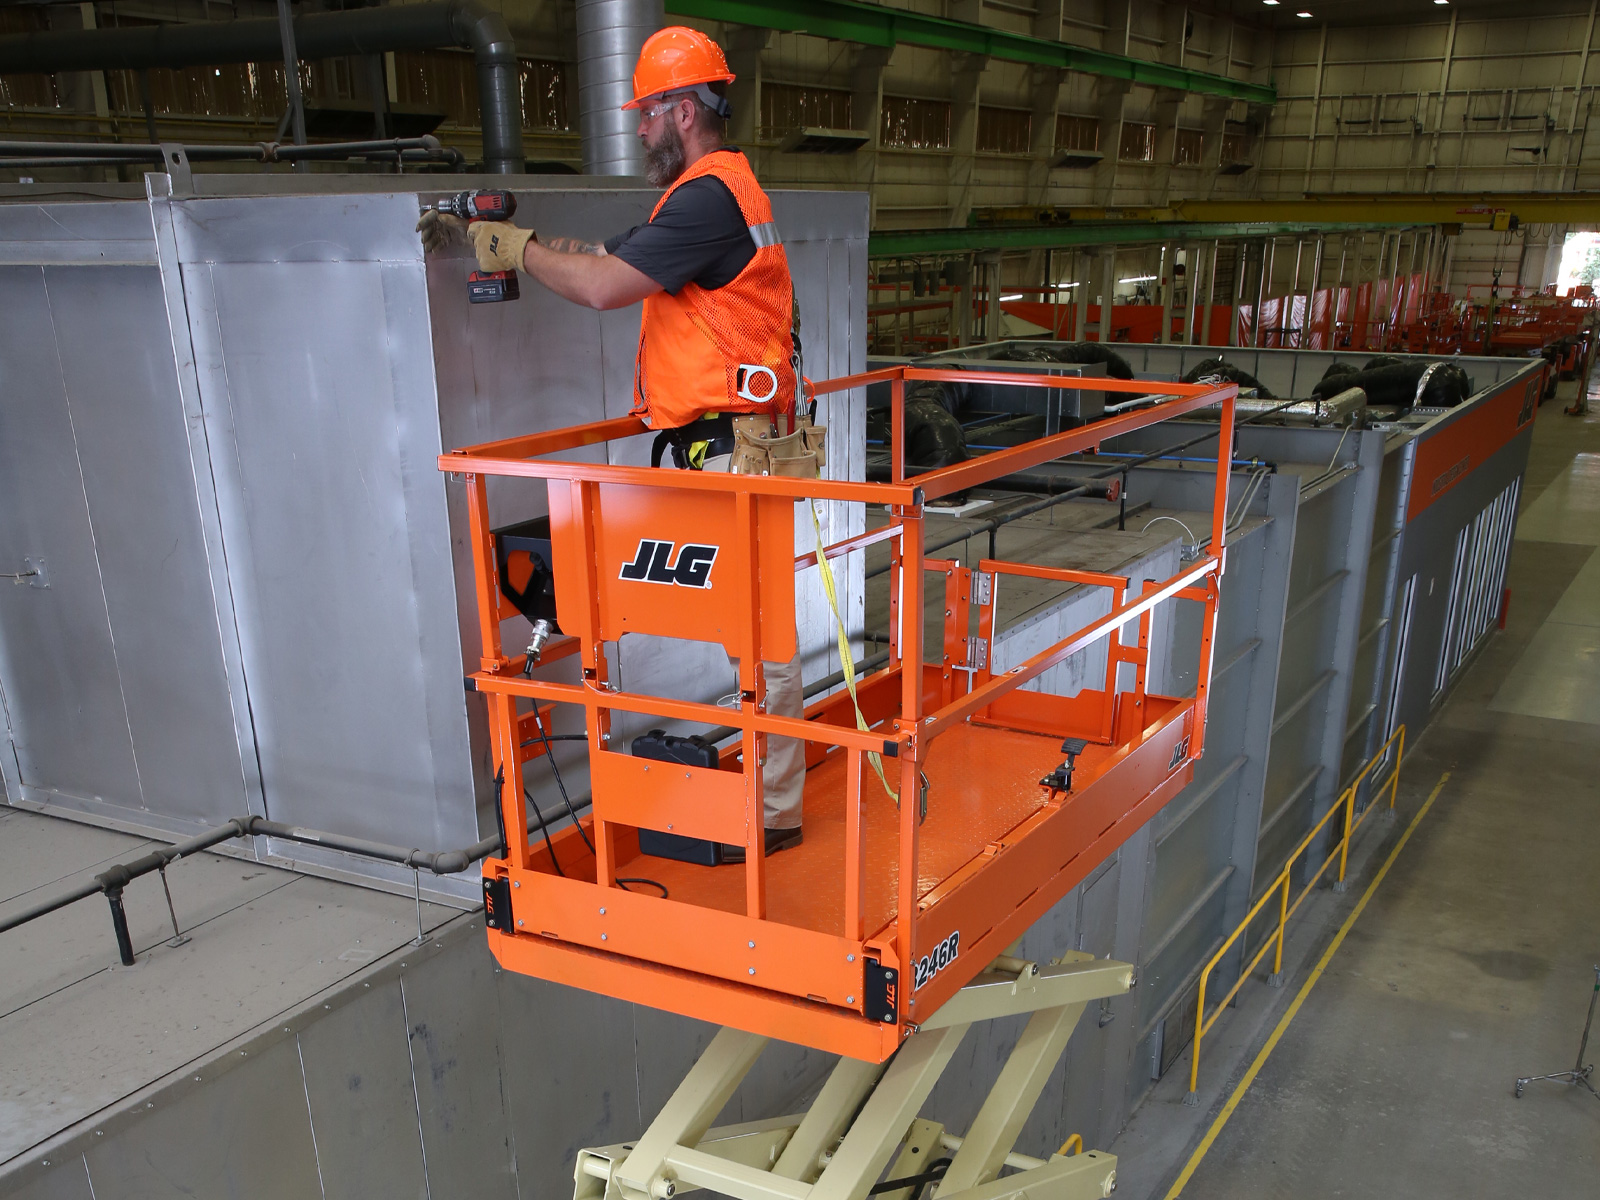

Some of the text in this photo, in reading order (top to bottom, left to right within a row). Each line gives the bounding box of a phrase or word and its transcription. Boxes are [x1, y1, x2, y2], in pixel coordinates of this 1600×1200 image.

[618, 538, 720, 588] JLG
[1168, 734, 1190, 772] JLG
[485, 890, 495, 915] JLG
[886, 983, 895, 1010] JLG
